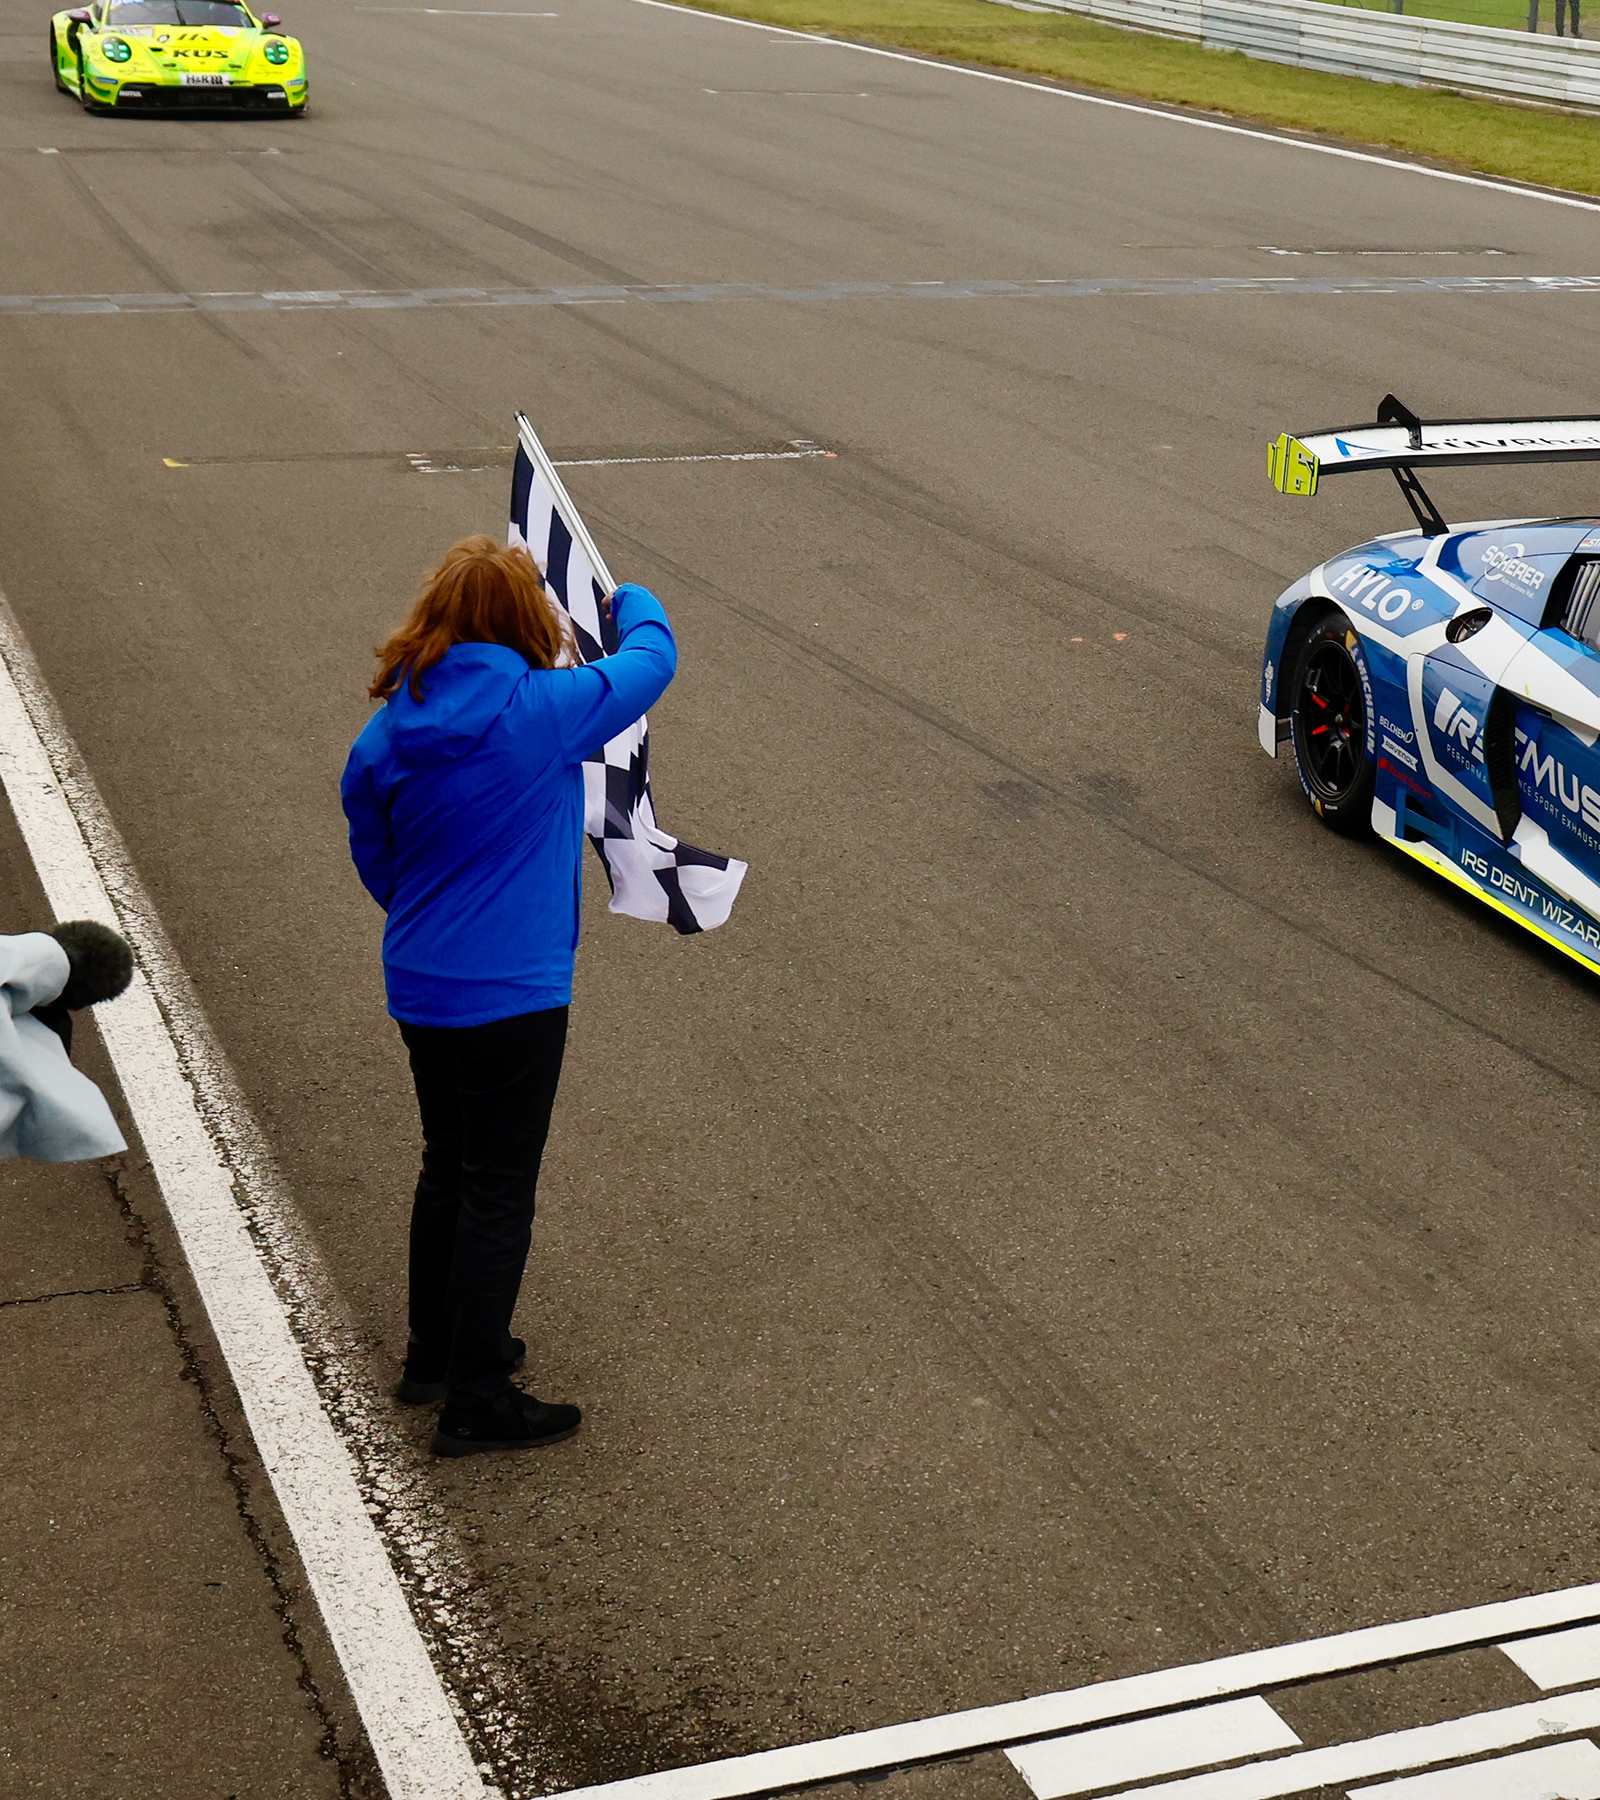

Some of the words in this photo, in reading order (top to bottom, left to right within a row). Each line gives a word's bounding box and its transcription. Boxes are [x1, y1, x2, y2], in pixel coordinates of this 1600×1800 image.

[1481, 545, 1546, 590] SCHERER
[1357, 659, 1376, 755] MICHELIN
[1385, 741, 1415, 766] RAVENOL
[1534, 791, 1559, 818] SPORT
[1461, 848, 1488, 878] IRS
[1490, 866, 1539, 907] DENT
